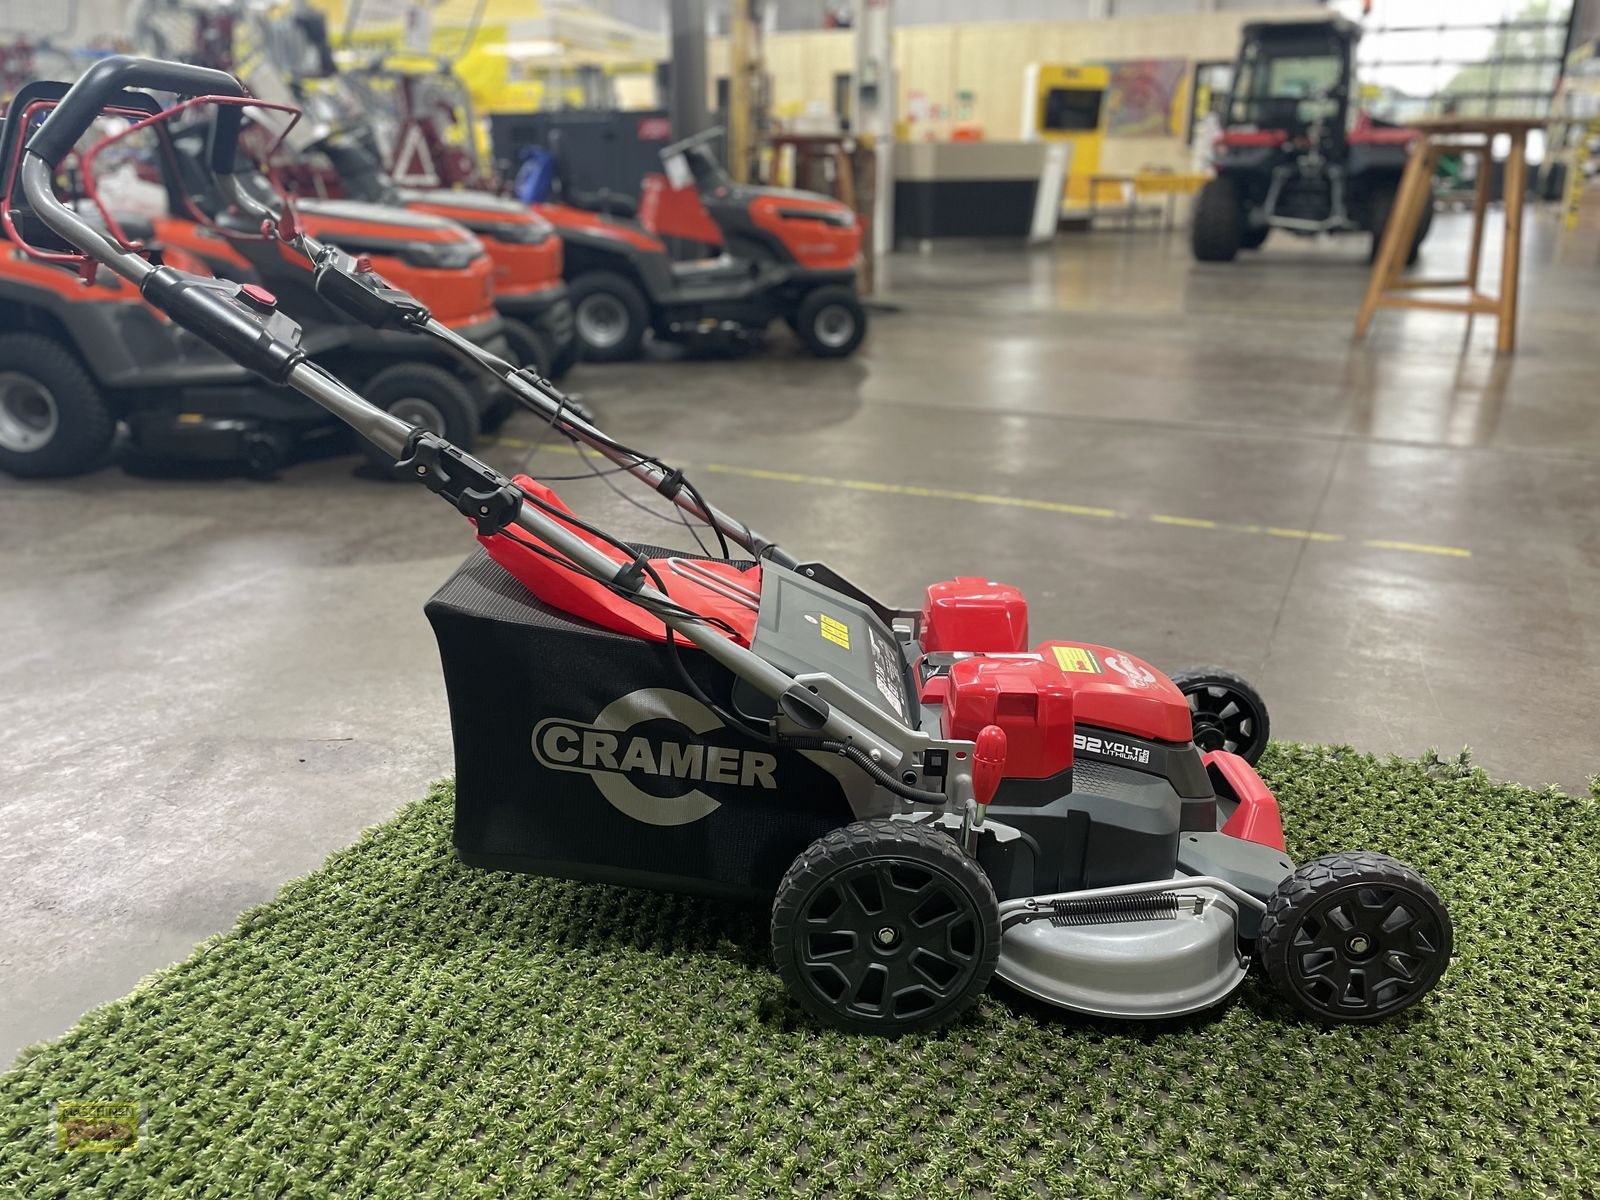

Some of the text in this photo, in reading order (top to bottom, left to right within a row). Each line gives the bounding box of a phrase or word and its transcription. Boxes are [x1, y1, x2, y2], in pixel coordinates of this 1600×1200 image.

[1102, 749, 1138, 761] LITHIUM
[1104, 740, 1142, 756] VOLT
[542, 726, 777, 789] CRAMER
